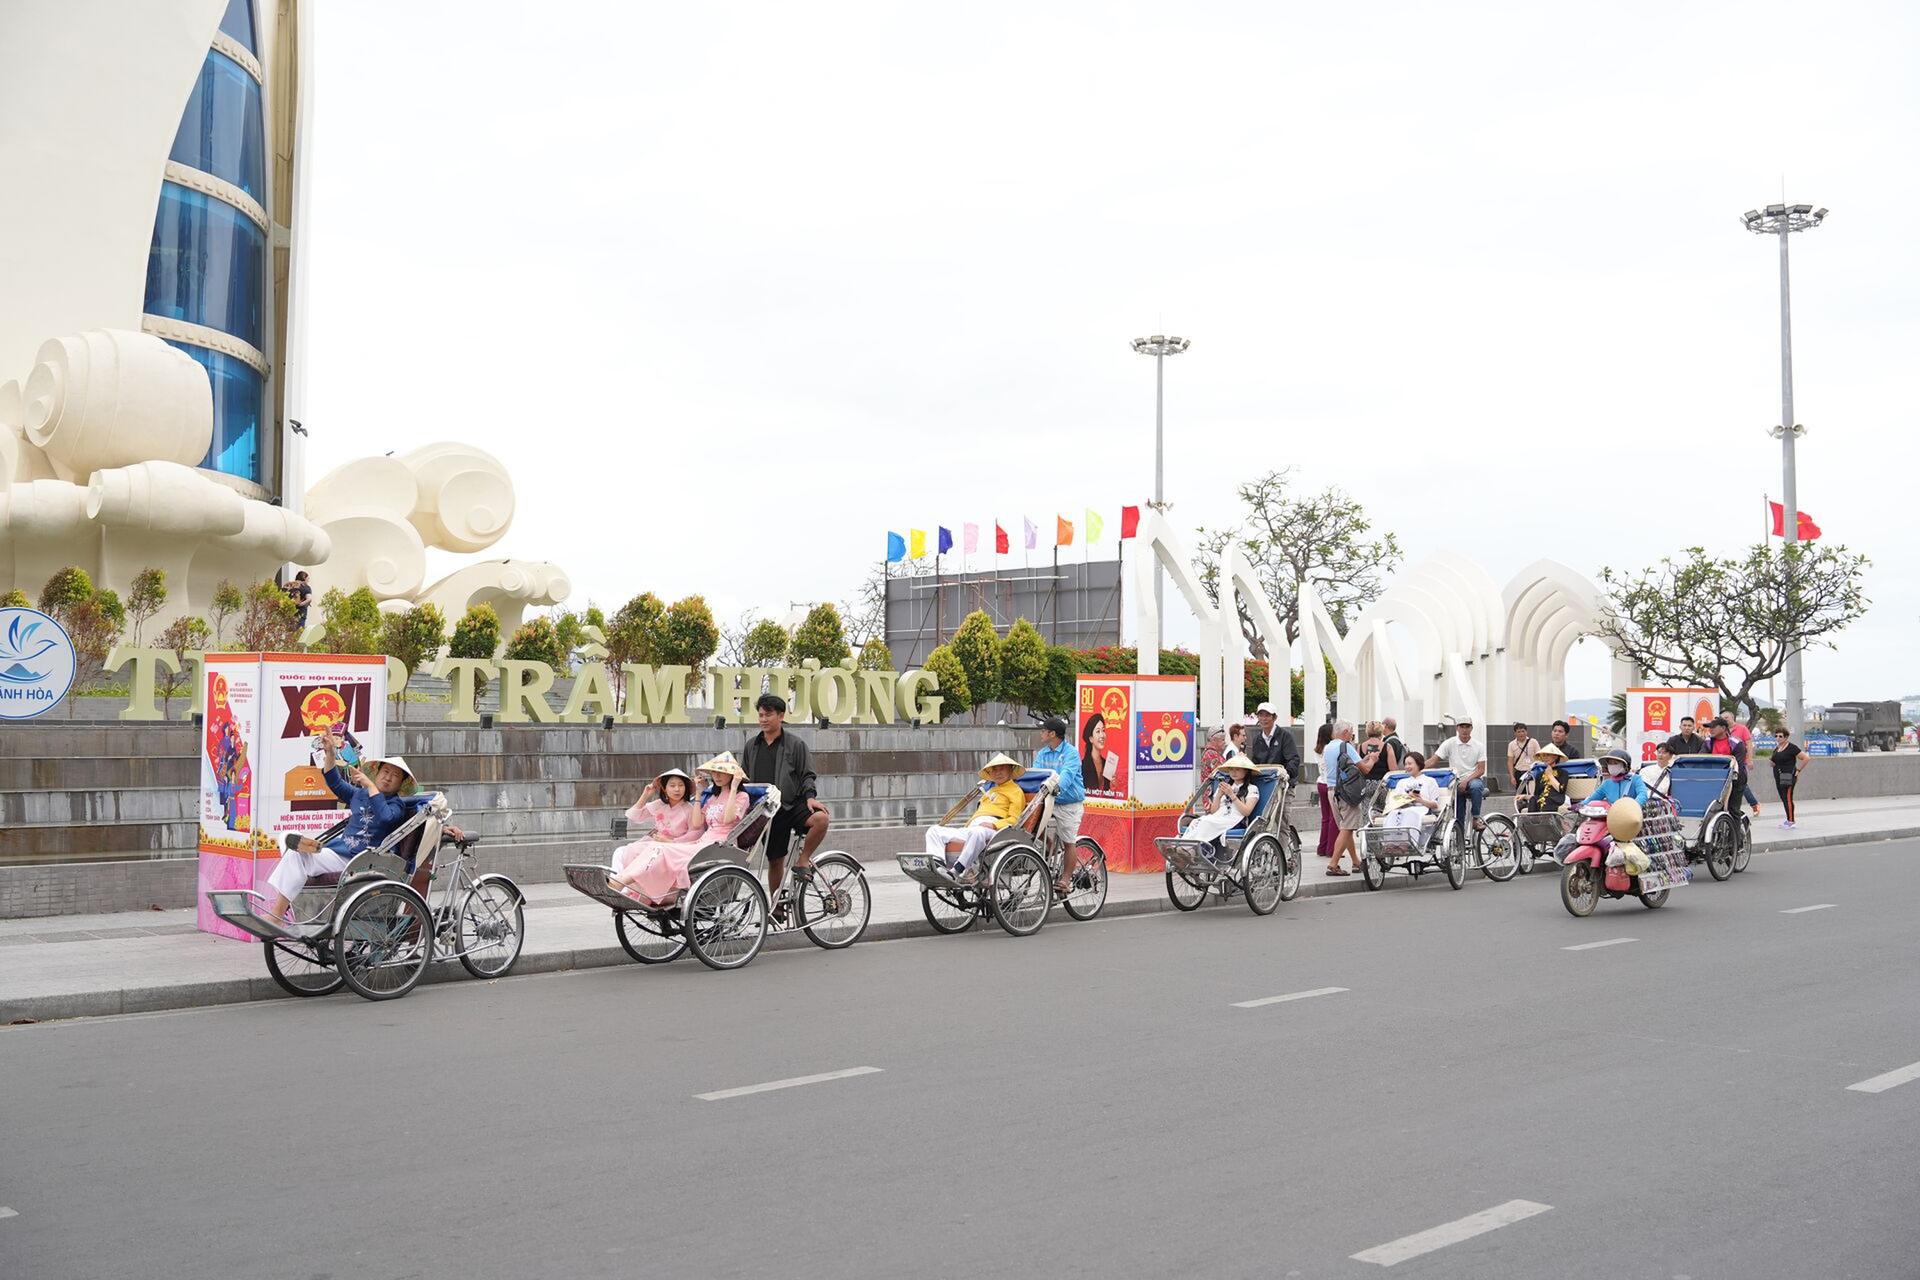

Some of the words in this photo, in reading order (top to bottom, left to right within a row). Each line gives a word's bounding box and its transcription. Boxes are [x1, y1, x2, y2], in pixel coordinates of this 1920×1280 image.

[431, 625, 691, 723] TRẦM
[708, 657, 945, 724] HƯƠNG
[26, 686, 53, 700] HÒA
[1081, 687, 1094, 706] 80
[1151, 728, 1187, 762] 80
[312, 812, 323, 820] CỦA
